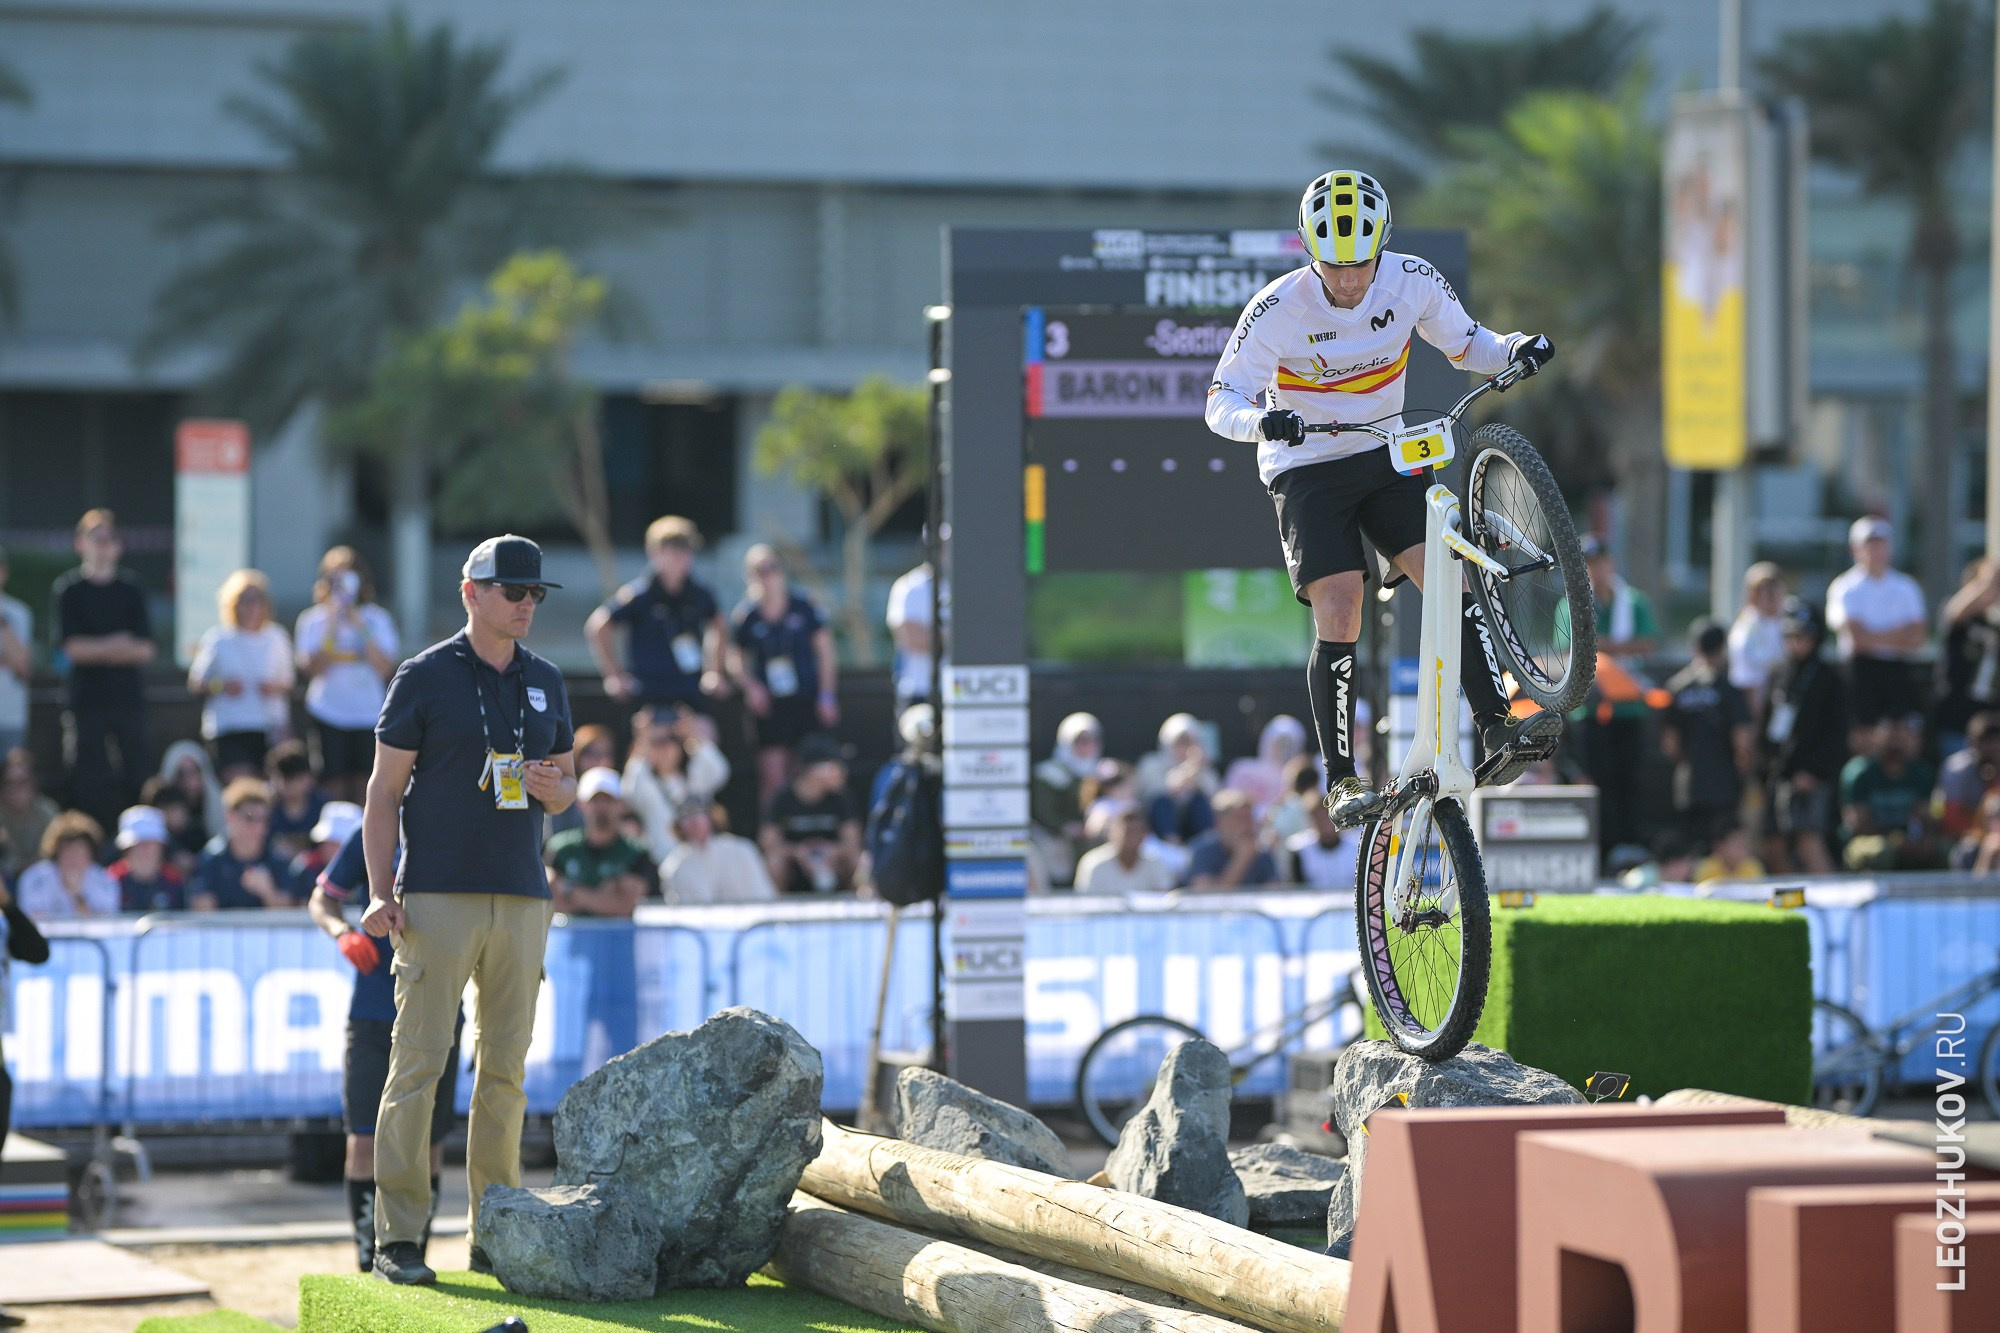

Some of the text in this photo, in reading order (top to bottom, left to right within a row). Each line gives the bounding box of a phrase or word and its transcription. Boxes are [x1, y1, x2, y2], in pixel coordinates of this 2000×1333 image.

[1145, 271, 1267, 306] FINISH
[1045, 320, 1069, 359] 3
[1056, 370, 1166, 402] BARON
[1417, 439, 1431, 458] 3
[1475, 623, 1509, 701] CLEAN
[965, 674, 1018, 696] UCI
[1336, 678, 1350, 758] CLEAN
[967, 949, 1021, 970] UCI
